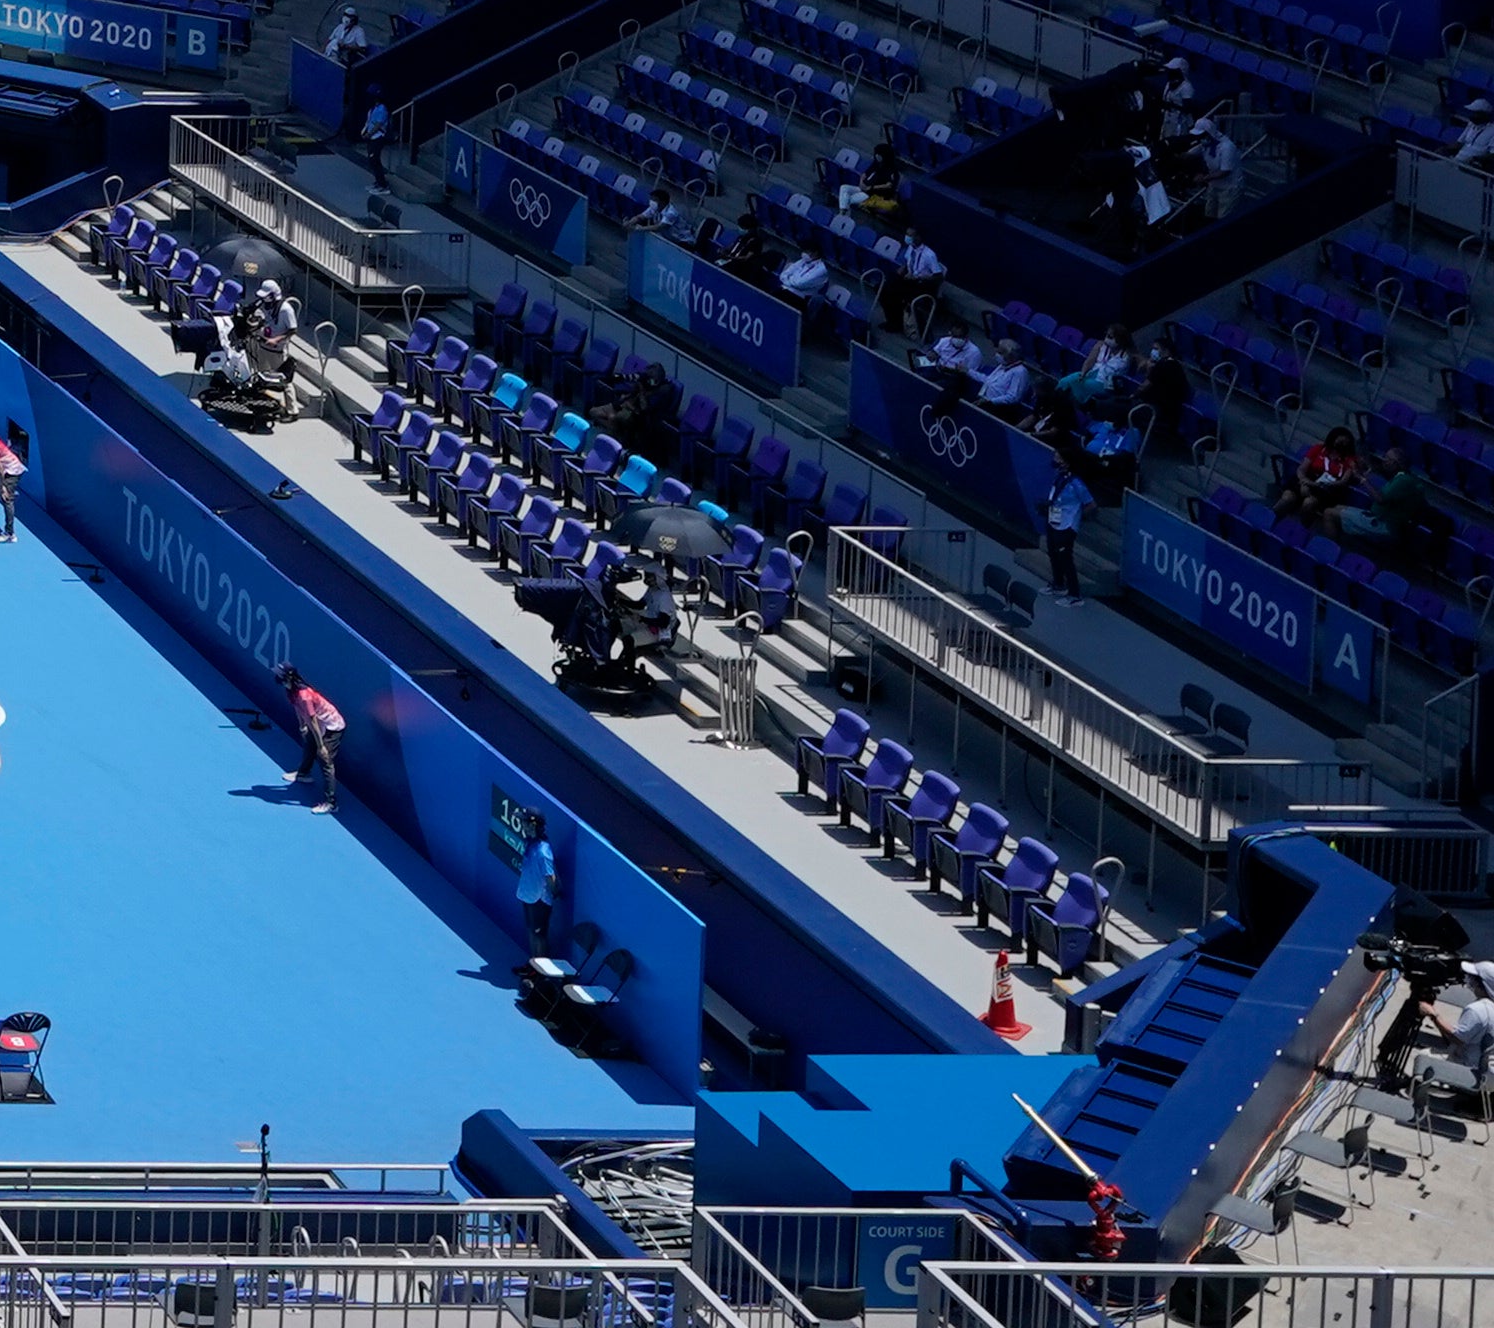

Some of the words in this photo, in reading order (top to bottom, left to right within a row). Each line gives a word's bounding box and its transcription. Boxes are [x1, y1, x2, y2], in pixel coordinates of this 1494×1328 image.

[2, 4, 84, 38] TOKYO
[89, 17, 152, 49] 2020
[189, 30, 206, 56] B
[455, 148, 467, 177] A
[657, 262, 714, 320] TOKYO
[717, 295, 765, 347] 2020
[120, 486, 212, 612] TOKYO
[216, 573, 293, 671] 2020
[1139, 529, 1222, 605] TOKYO
[1227, 576, 1299, 647] 2020
[1336, 634, 1359, 680] A
[869, 1225, 914, 1239] COURT
[916, 1225, 945, 1239] SIDE
